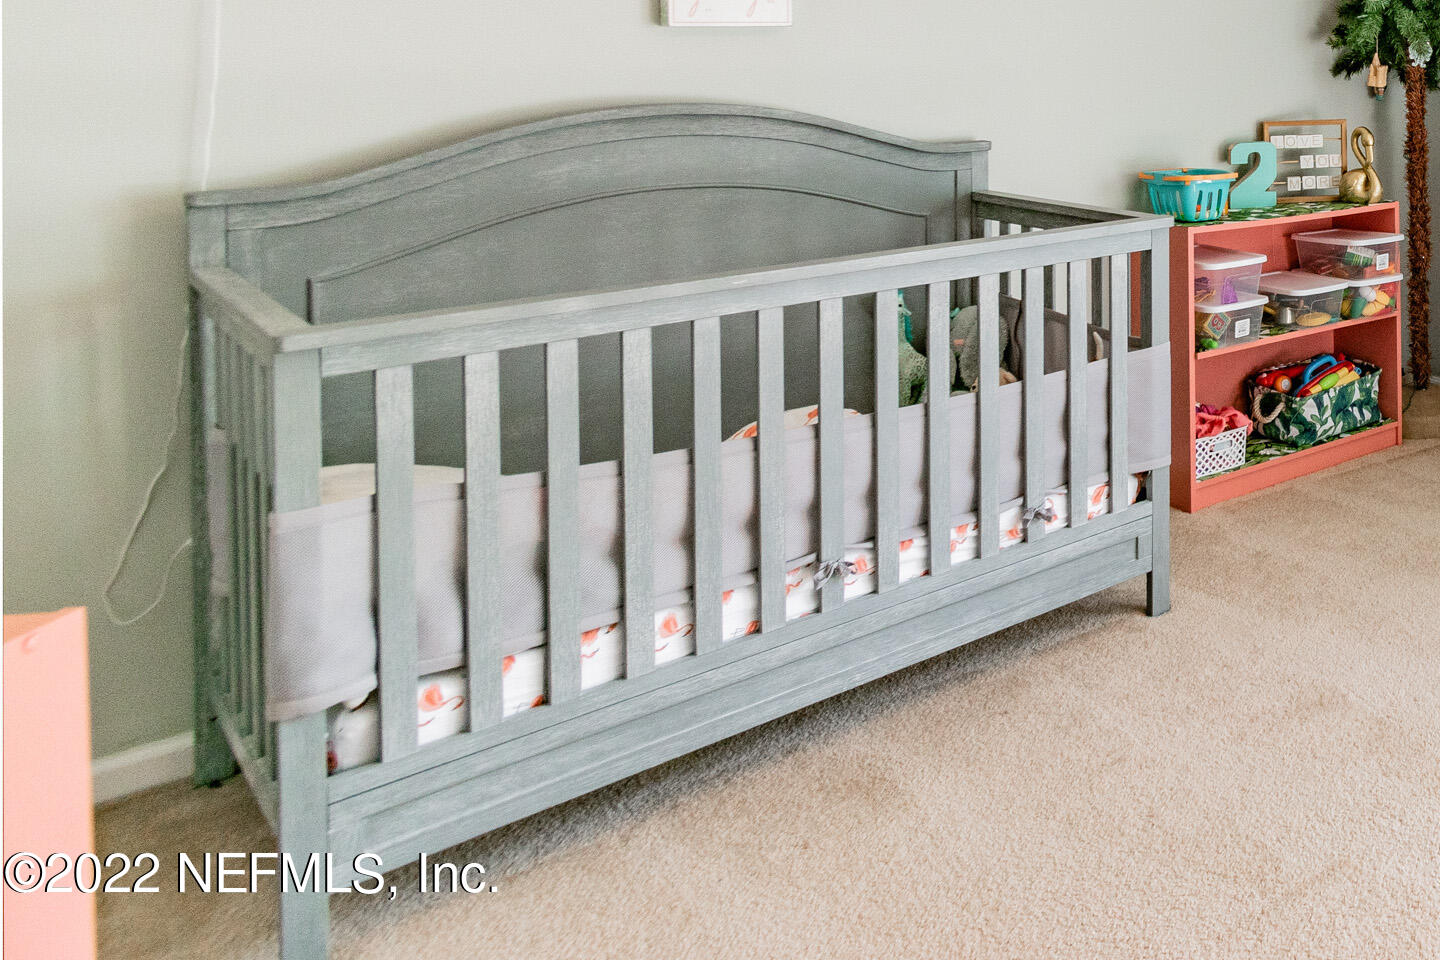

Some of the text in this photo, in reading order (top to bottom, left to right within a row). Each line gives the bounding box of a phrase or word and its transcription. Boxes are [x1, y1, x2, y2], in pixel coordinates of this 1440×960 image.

[1304, 155, 1341, 167] YOU
[1227, 141, 1277, 208] 2
[1289, 177, 1340, 190] MORE
